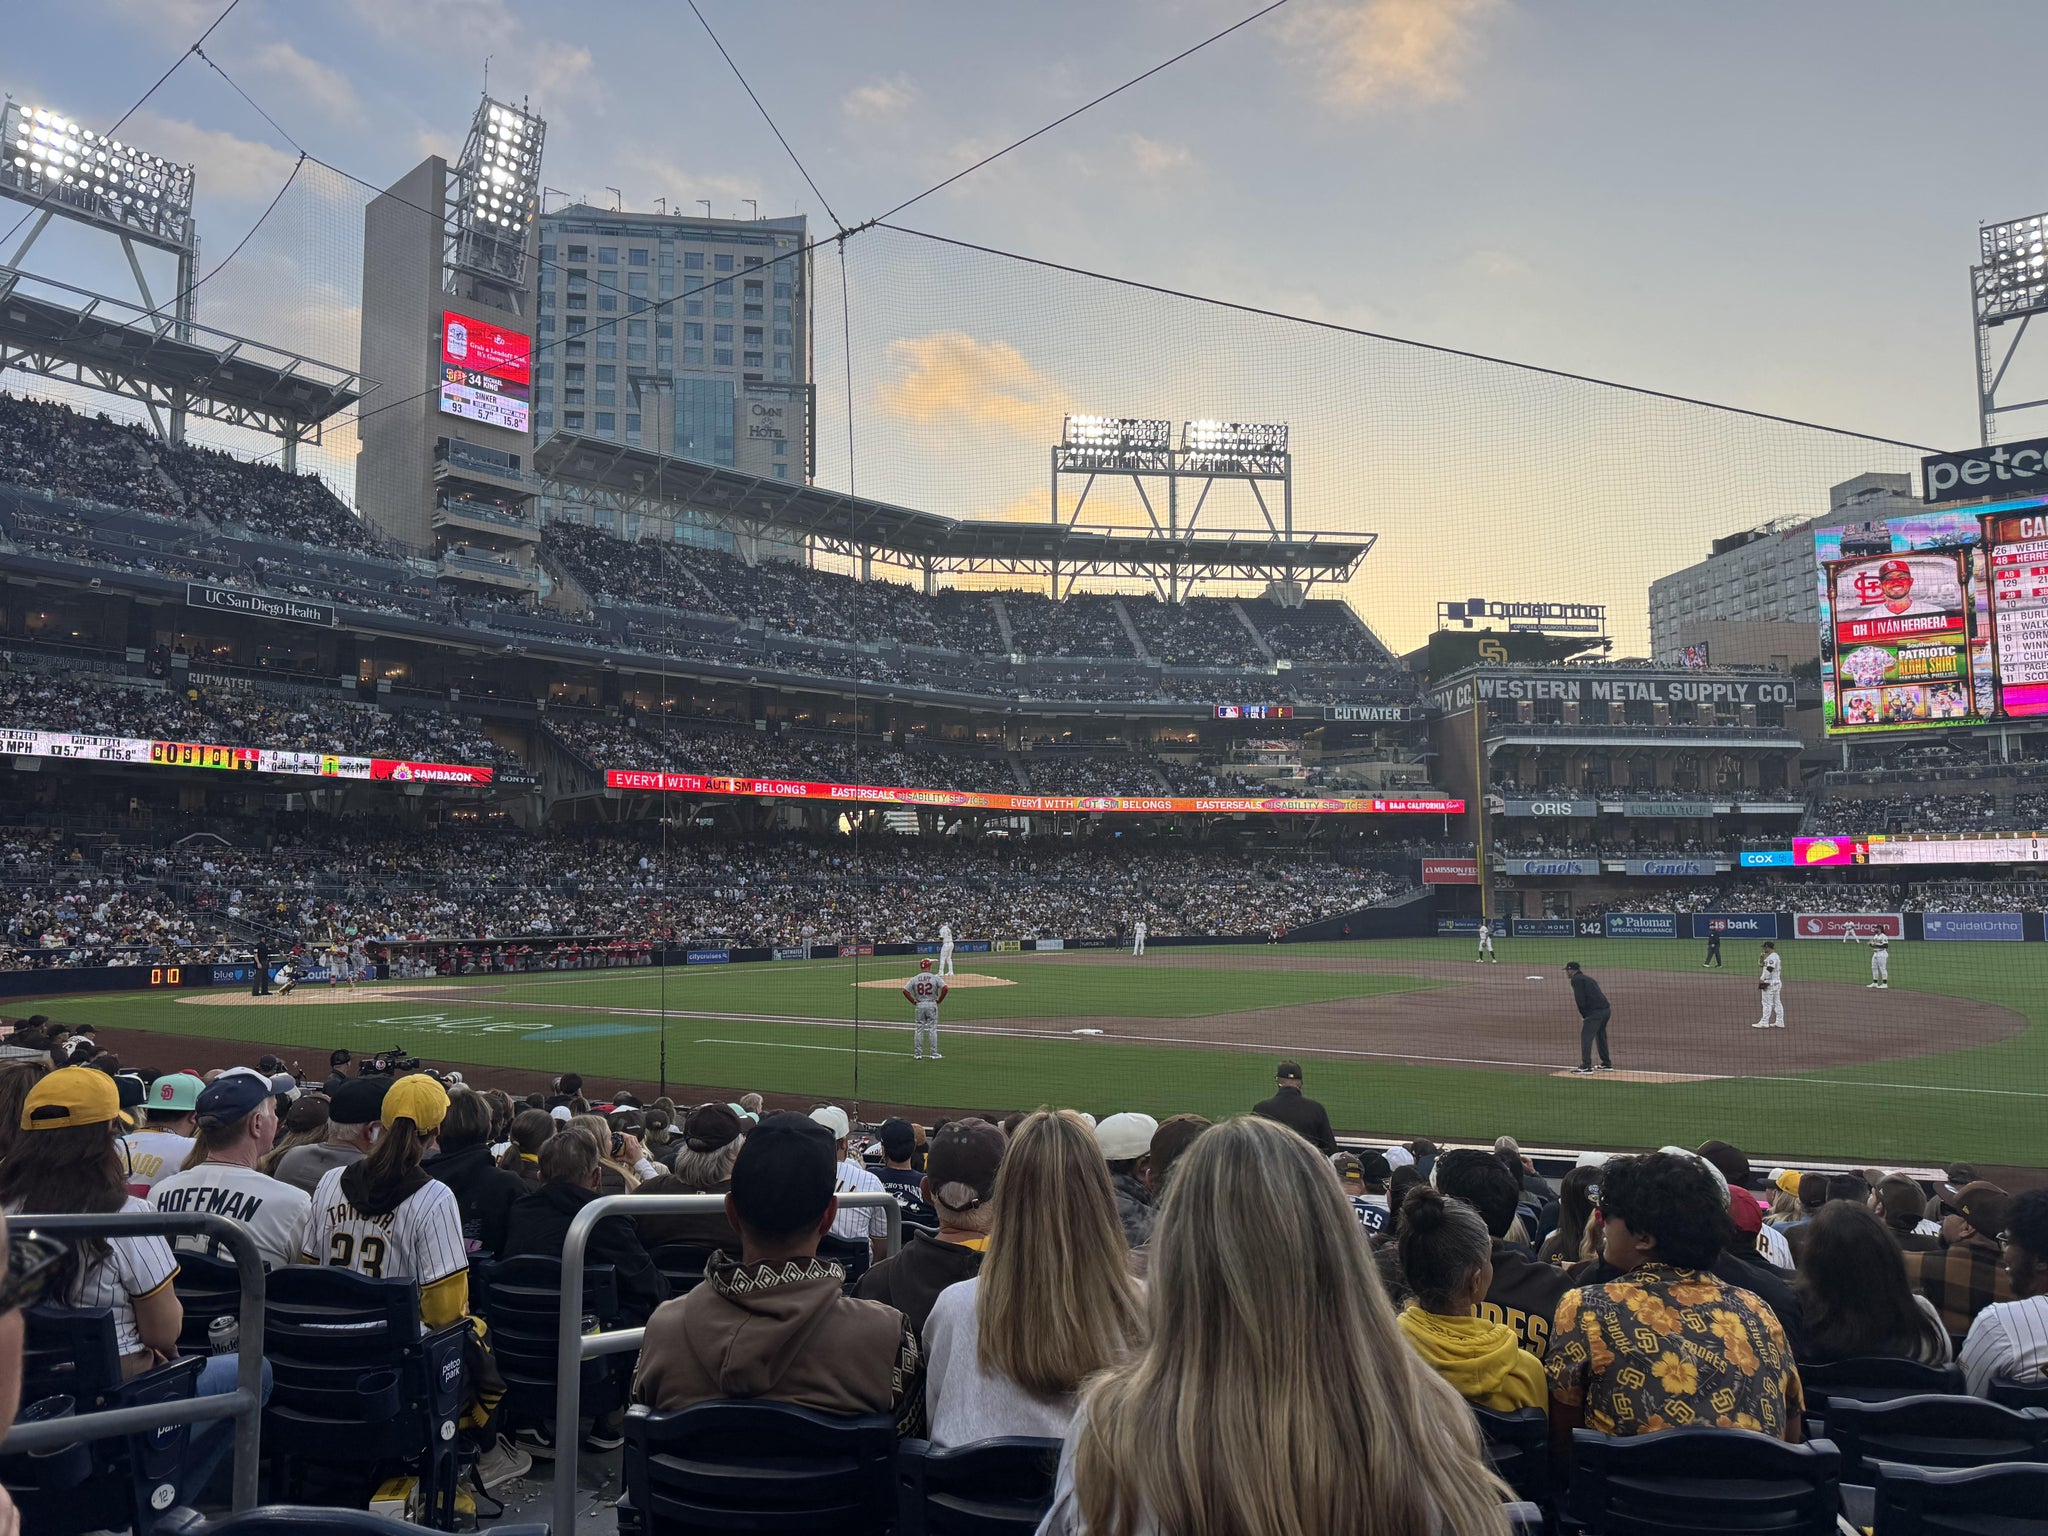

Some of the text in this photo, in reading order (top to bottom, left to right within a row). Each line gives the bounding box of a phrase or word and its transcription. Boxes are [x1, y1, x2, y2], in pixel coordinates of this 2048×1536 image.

[468, 373, 481, 386] 34
[483, 382, 498, 391] KING
[474, 391, 497, 404] SINKER
[452, 402, 462, 413] 93
[478, 410, 493, 420] 5.7"
[504, 416, 523, 428] 15.8"
[1927, 446, 2048, 500] petc
[2020, 515, 2048, 538] CA
[1996, 547, 2007, 555] 26
[1996, 556, 2008, 565] 48
[2004, 570, 2014, 578] AB
[2003, 579, 2017, 588] 129
[205, 590, 321, 621] UC San Diego Health
[2007, 600, 2016, 608] 10
[1490, 602, 1599, 620] QuidelOrtho
[1852, 616, 1948, 637] DH IVÁN HERRERA
[2002, 624, 2012, 632] 18
[2003, 634, 2012, 642] 16
[1898, 646, 1956, 660] PATRIOTIC
[2005, 644, 2011, 652] 0
[1899, 655, 1957, 675] ALOHA SHIRT
[188, 672, 252, 689] CUTWATER
[1456, 684, 1474, 707] CO.
[1477, 679, 1794, 703] WESTERN METAL SUPPLY CO.
[1335, 708, 1400, 720] CUTWATER
[12, 731, 36, 740] SPEED
[73, 736, 94, 745] PITCH
[7, 741, 33, 753] MPH
[64, 746, 84, 757] 5.7"
[112, 749, 136, 760] 15.8"
[199, 746, 205, 765] 1
[227, 748, 233, 767] 1
[414, 769, 472, 782] SAMBAZON
[500, 775, 525, 783] SONY
[616, 774, 664, 788] EVERY1
[668, 777, 701, 789] WITH
[755, 782, 807, 795] BELONGS
[831, 787, 989, 806] EASTERSEALS DISABILITY SERVICES
[1011, 797, 1041, 809] EVERY1
[1045, 800, 1074, 809] WITH
[1122, 800, 1172, 809] BELONGS
[1196, 800, 1262, 809] EASTERSEALS
[1265, 800, 1319, 810] DISABILITY
[1322, 801, 1368, 810] SERVICES
[1531, 802, 1572, 816] ORIS
[2032, 839, 2037, 848] 0
[1748, 855, 1773, 863] COX
[2033, 851, 2038, 860] 0
[1433, 866, 1463, 874] MISSION
[1524, 860, 1582, 875] Canel's
[1644, 860, 1699, 875] Canel's
[1494, 877, 1515, 888] 336
[1580, 922, 1601, 934] 342
[1626, 917, 1672, 927] Palomar
[1727, 919, 1758, 929] bank
[1946, 921, 2018, 932] QuidelOrtho
[152, 968, 180, 984] 0 10
[213, 970, 234, 979] blue
[917, 983, 932, 995] 82
[157, 1187, 263, 1223] HOFFMAN
[329, 1233, 386, 1279] 23
[1604, 1311, 1634, 1353] PADRES
[1747, 1319, 1770, 1364] PADRES
[1681, 1340, 1728, 1374] PADRES
[442, 1358, 460, 1376] petco
[446, 1366, 460, 1383] park
[445, 1425, 452, 1436] 11
[158, 1489, 169, 1503] 12
